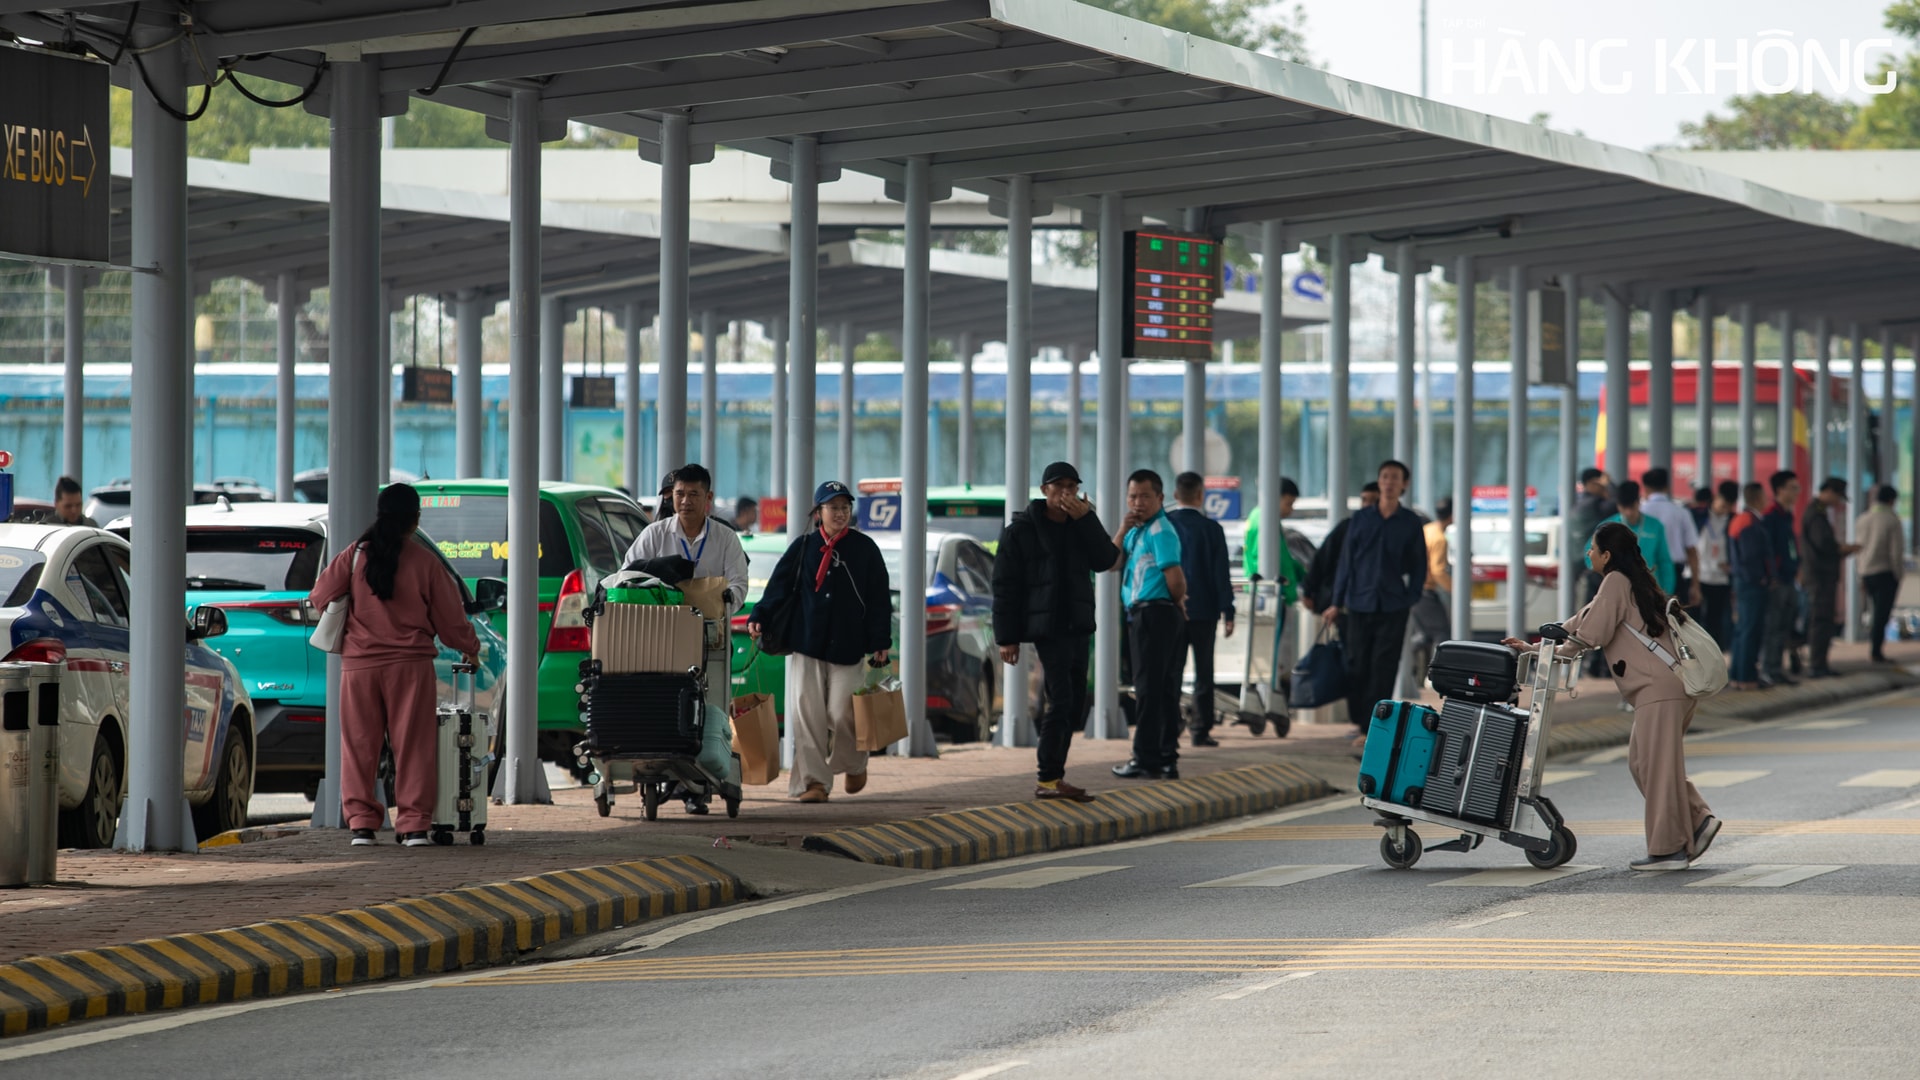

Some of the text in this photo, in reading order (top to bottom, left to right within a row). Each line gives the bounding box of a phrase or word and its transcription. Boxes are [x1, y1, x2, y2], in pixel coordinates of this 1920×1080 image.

[3, 123, 66, 186] XE BUS
[421, 496, 461, 508] XE TAXI
[869, 498, 898, 528] G7
[1205, 493, 1231, 518] G7
[279, 541, 307, 549] TAXI
[191, 710, 206, 733] TAXI
